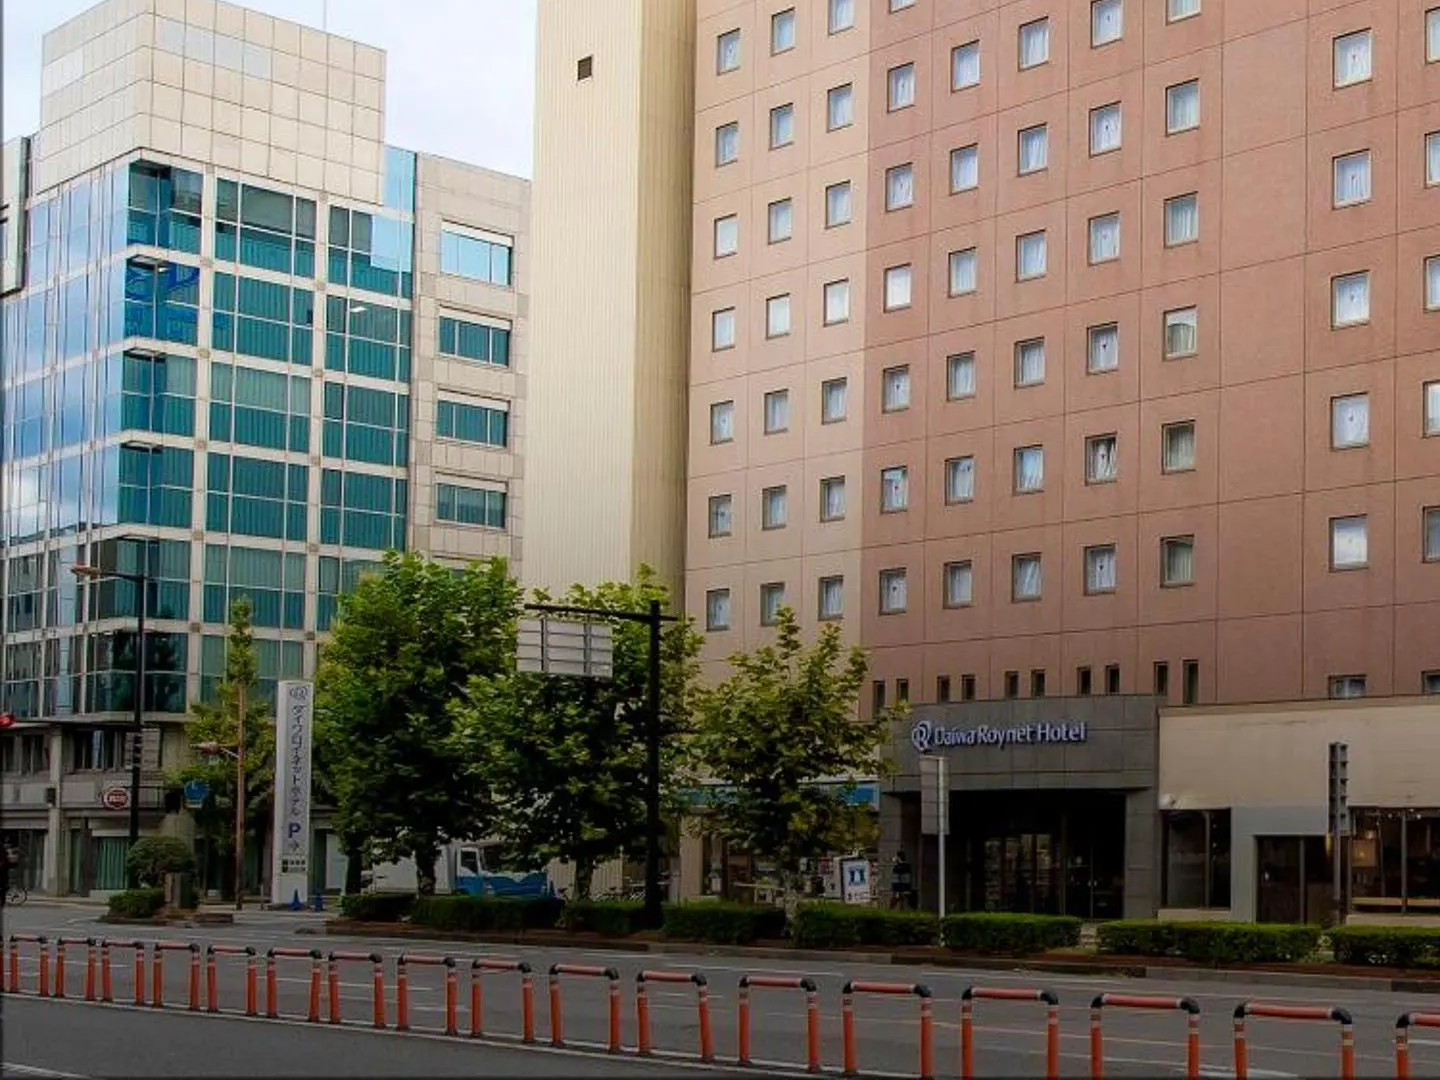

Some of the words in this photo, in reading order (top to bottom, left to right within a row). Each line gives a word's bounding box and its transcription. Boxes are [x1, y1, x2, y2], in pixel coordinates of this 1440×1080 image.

[934, 726, 976, 746] Daiwa
[977, 724, 1036, 750] Roynet
[1037, 722, 1088, 743] Hotel
[288, 822, 302, 839] P
